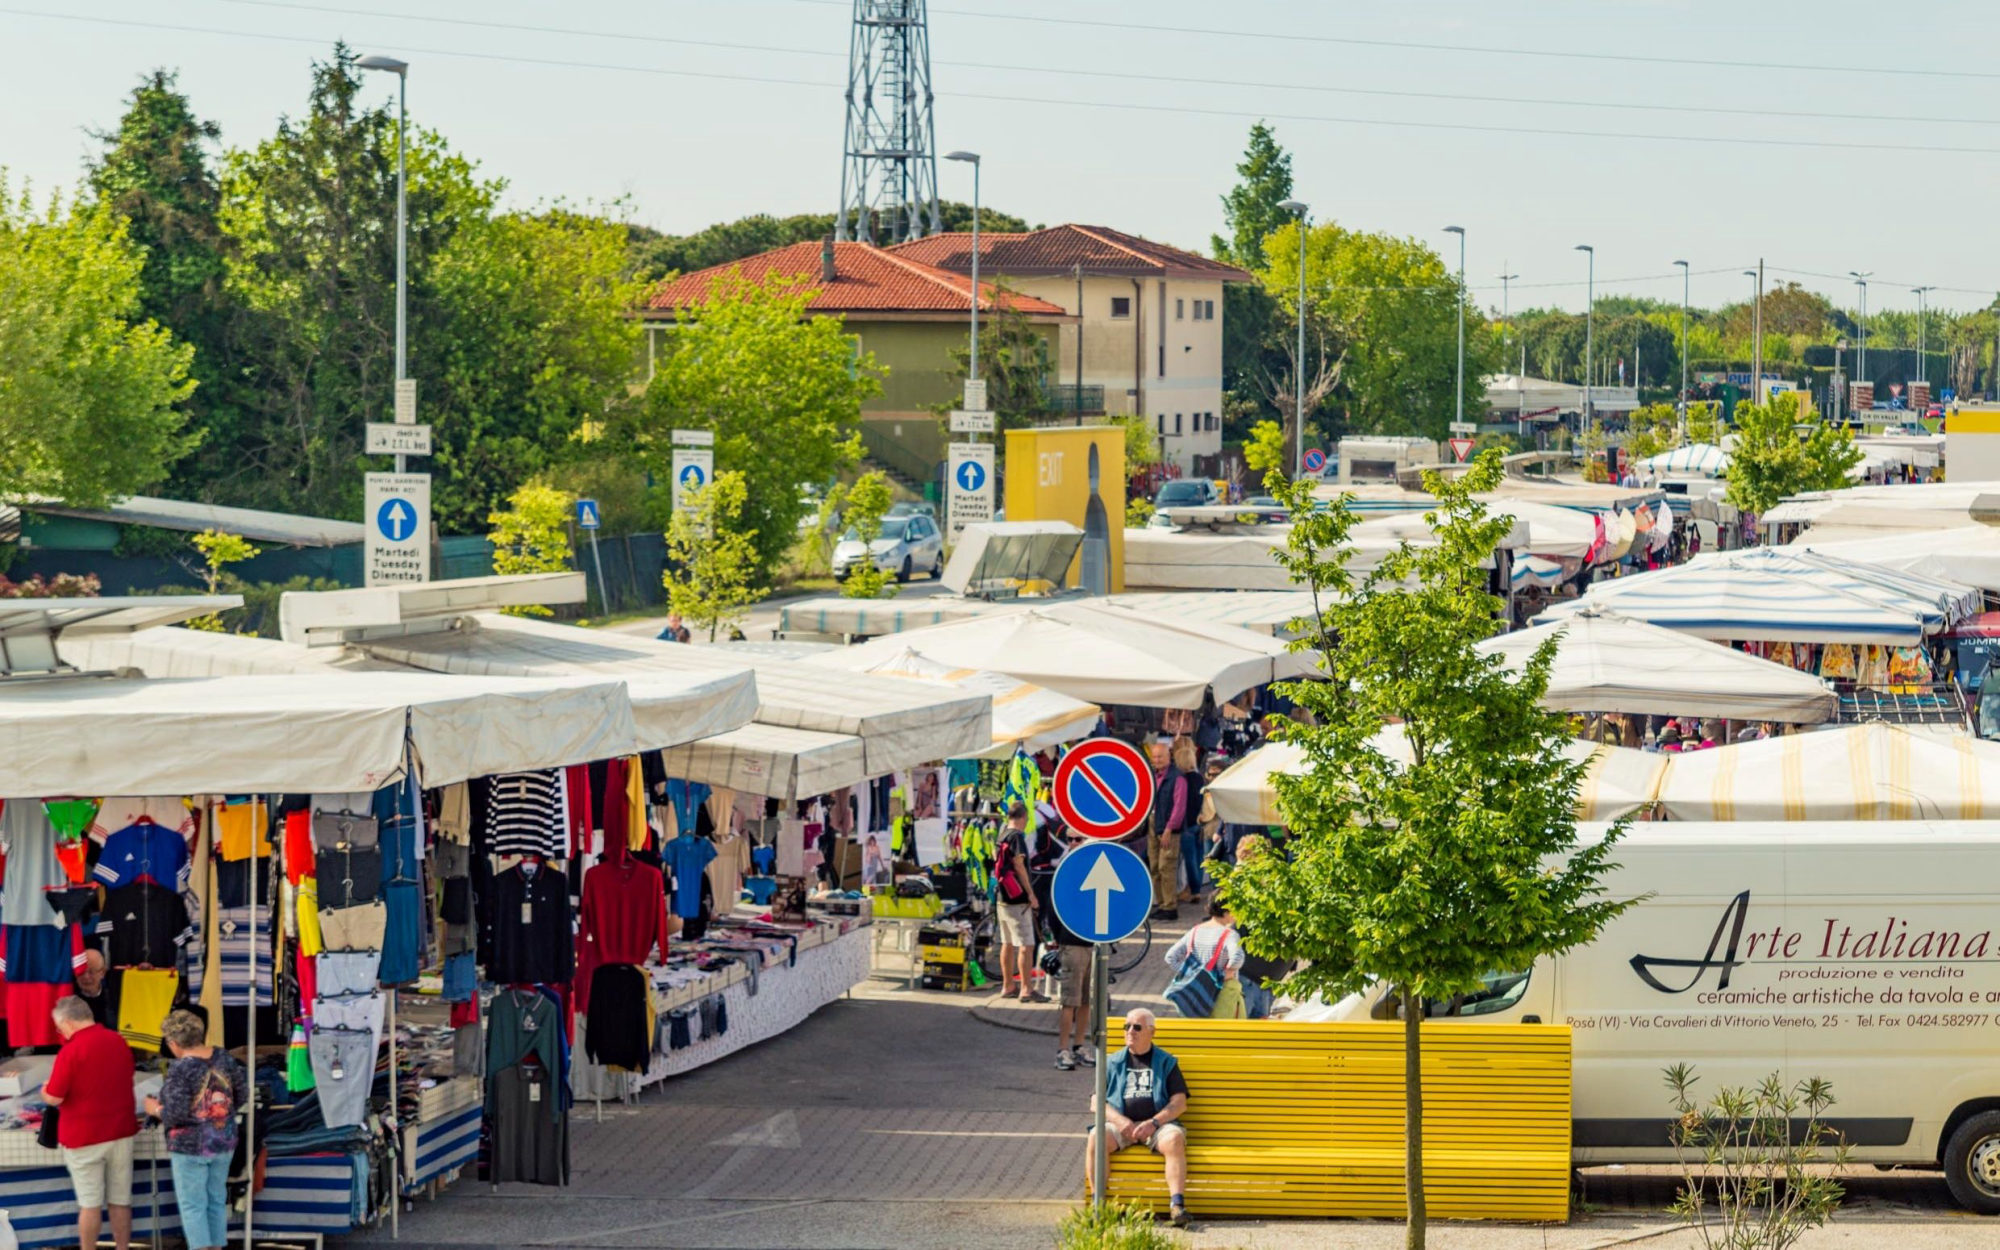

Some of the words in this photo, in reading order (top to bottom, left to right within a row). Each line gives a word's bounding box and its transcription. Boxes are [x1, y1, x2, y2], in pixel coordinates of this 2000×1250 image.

[1039, 451, 1064, 487] EXIT
[373, 558, 421, 571] Tuesday
[371, 569, 423, 582] Dienstag
[1629, 889, 1802, 994] Arte
[1816, 917, 1991, 959] Italiana
[1778, 965, 1877, 982] produzione
[1883, 969, 1894, 979] e
[1899, 965, 1964, 979] vendita
[1696, 986, 1787, 1004] ceramiche
[1792, 986, 1874, 1004] artistiche
[1879, 986, 1903, 1004] da
[1908, 986, 1963, 1004] tavola
[1969, 990, 1980, 1004] e
[1598, 1015, 1620, 1031] (VI)
[1629, 1015, 1650, 1028] Via
[1653, 1014, 1707, 1028] Cavalieri
[1710, 1014, 1721, 1028] di
[1724, 1014, 1770, 1028] Vittorio
[1772, 1015, 1817, 1029] Veneto,
[1822, 1015, 1839, 1028] 25
[1856, 1014, 1875, 1028] Tel.
[1878, 1014, 1901, 1028] Fax
[1906, 1014, 1989, 1028] 0424.582977
